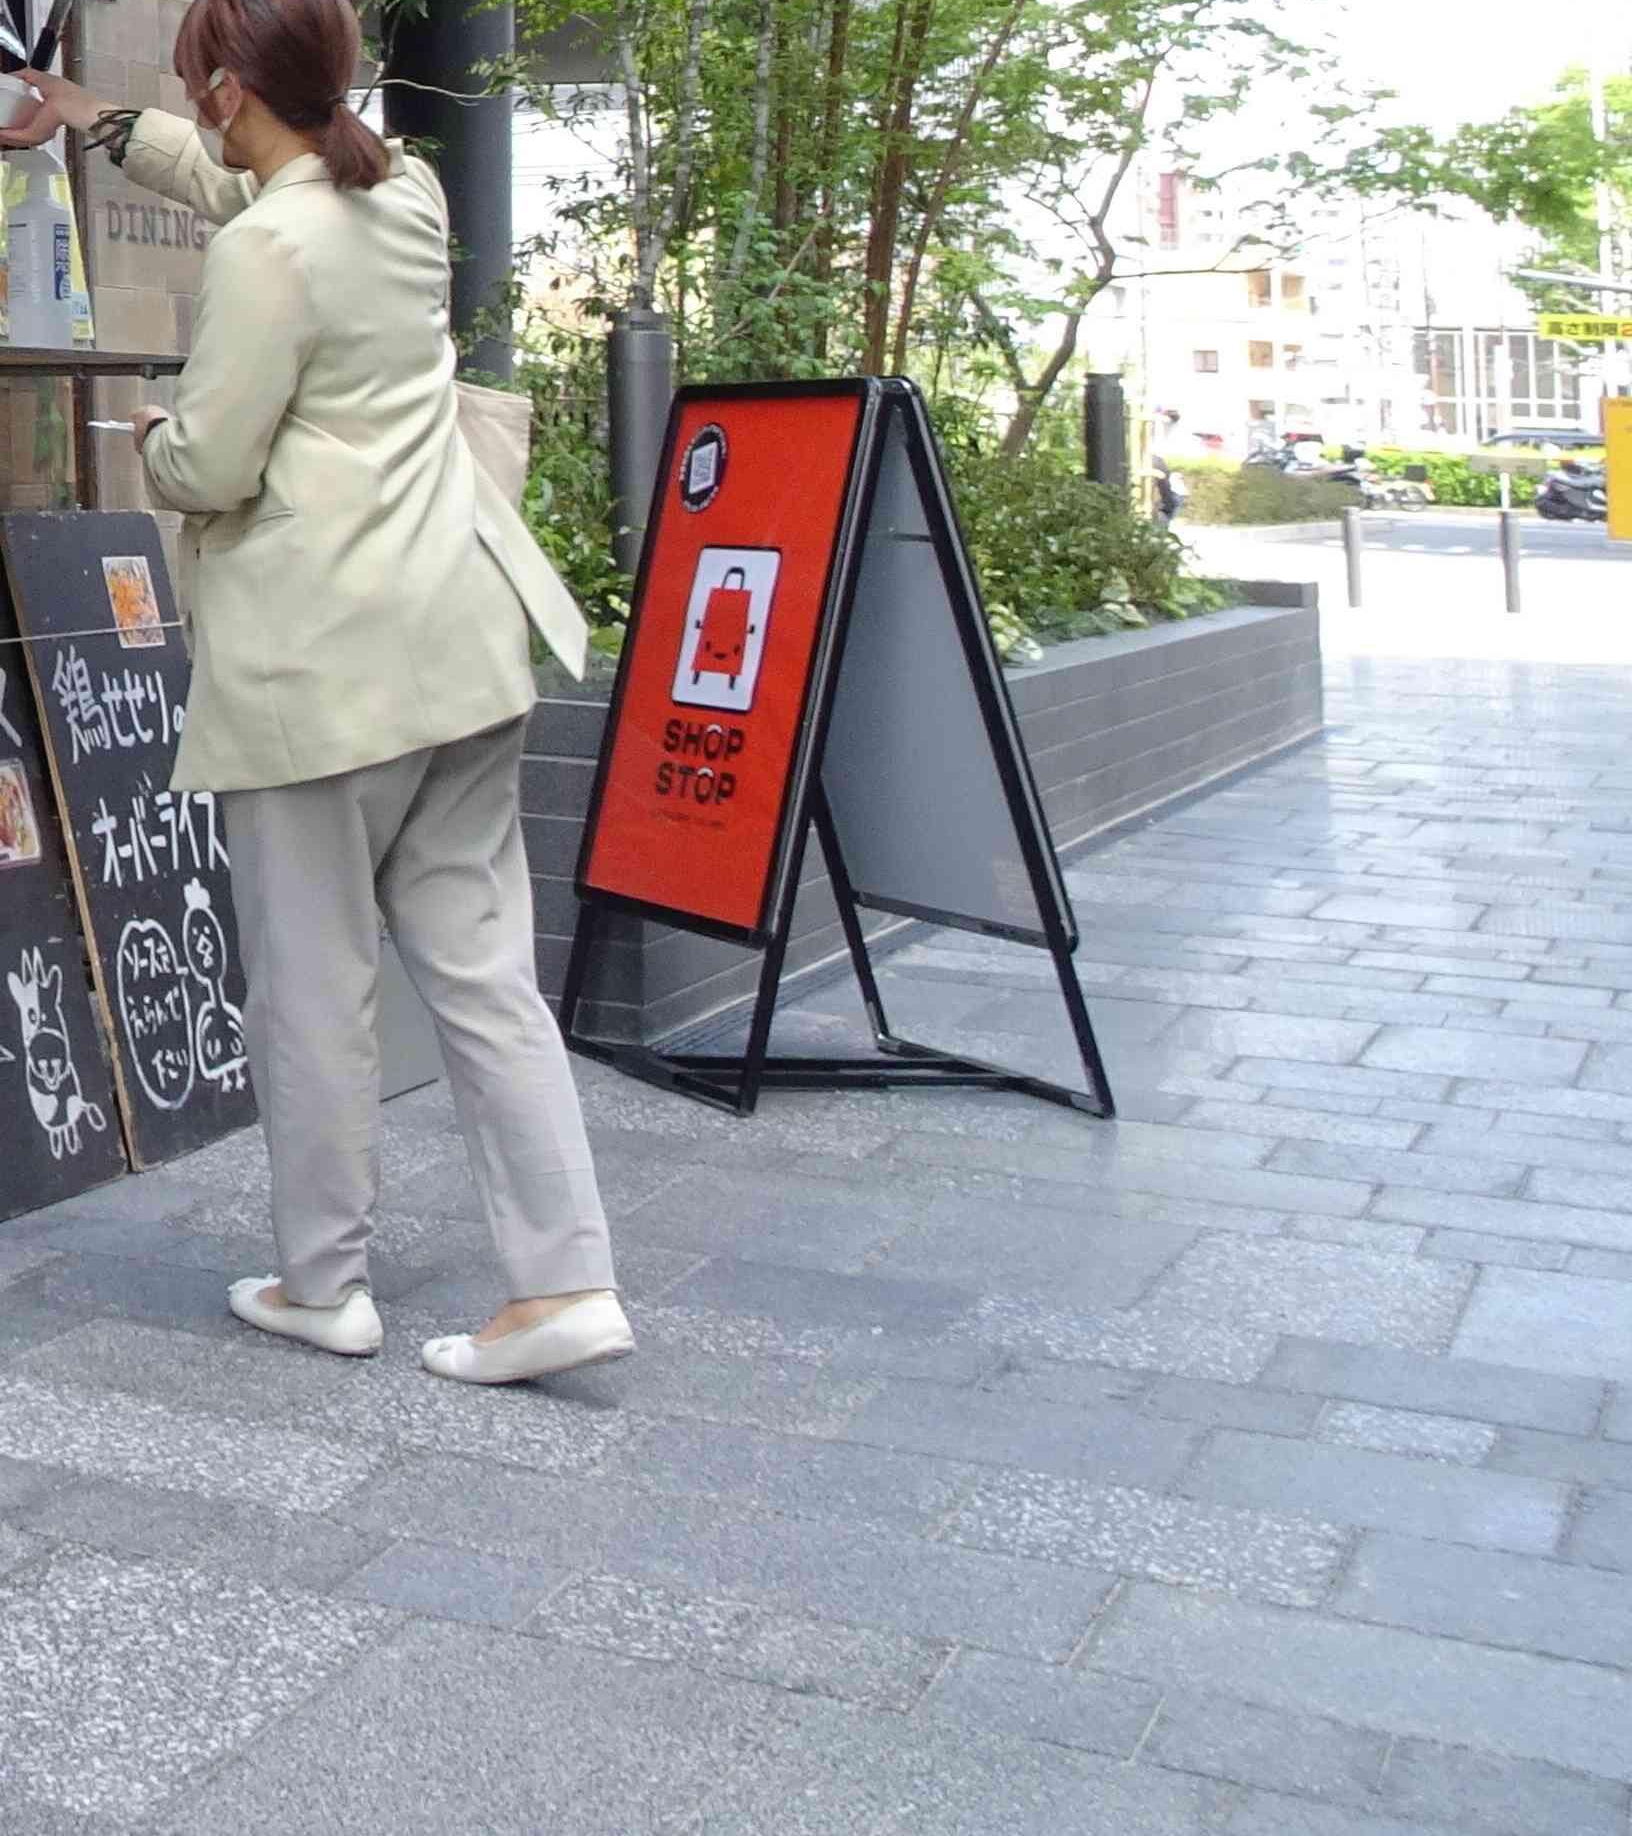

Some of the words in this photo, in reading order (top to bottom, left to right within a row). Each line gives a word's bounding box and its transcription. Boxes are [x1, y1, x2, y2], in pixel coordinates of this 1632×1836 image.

[105, 199, 209, 251] DINING
[663, 718, 745, 761] SHOP
[655, 761, 736, 805] STOP
[91, 790, 232, 889] オーバーライス
